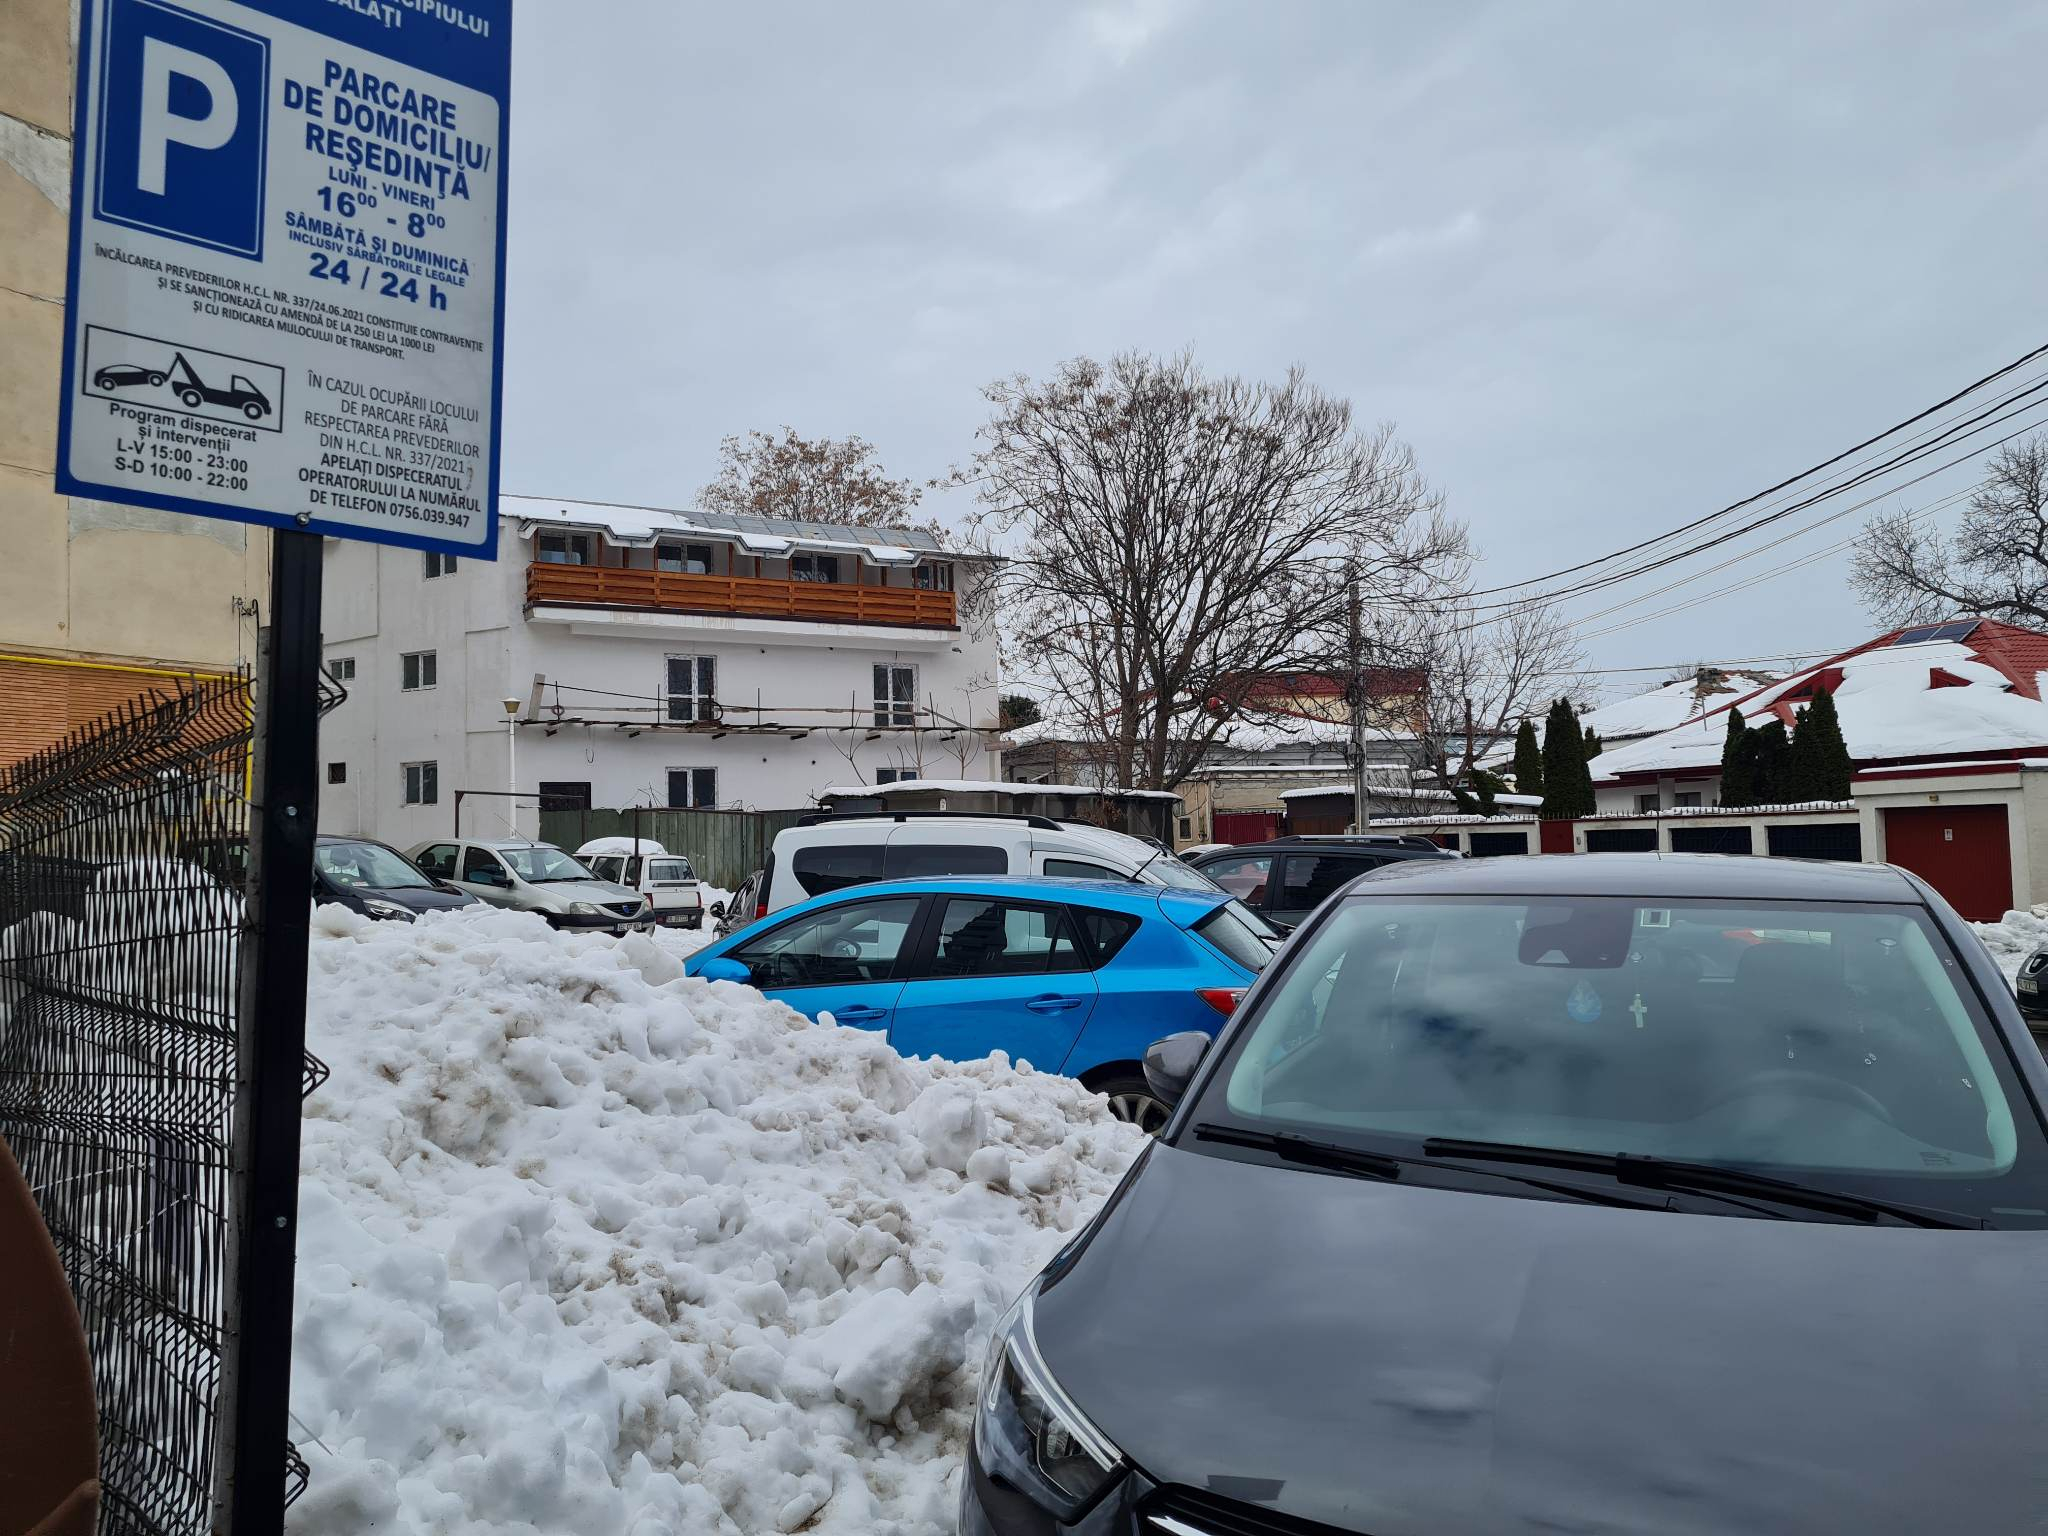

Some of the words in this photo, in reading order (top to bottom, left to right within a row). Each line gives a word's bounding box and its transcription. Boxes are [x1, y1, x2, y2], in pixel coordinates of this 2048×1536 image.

[393, 0, 489, 37] IPIULUI
[136, 36, 239, 196] P
[324, 59, 456, 131] PARCARE
[284, 78, 323, 118] DE
[334, 96, 491, 173] DOMICILIU/
[329, 166, 367, 190] LUNI
[382, 183, 435, 211] VINERI
[285, 211, 366, 247] SÂMBĂTĂ
[392, 242, 469, 276] DUMINICĂ
[289, 230, 343, 252] INCLUSIV
[426, 265, 465, 287] LEGALE
[94, 243, 162, 272] ÎNCĂLCAREA
[165, 263, 240, 292] PREVEDERILOR
[273, 291, 290, 303] NR.
[293, 295, 364, 322] 337/24.06.2021
[366, 314, 418, 336] CONSTITUIE
[309, 252, 350, 285] 24
[361, 266, 370, 290] /
[380, 272, 419, 303] 24
[430, 284, 447, 311] h
[170, 280, 182, 292] SE
[265, 301, 279, 314] CU
[281, 306, 323, 326] AMENDĂ
[326, 318, 338, 330] DE
[340, 321, 351, 333] LA
[354, 324, 370, 338] 250
[373, 329, 385, 341] LEI
[387, 332, 398, 344] LA
[400, 336, 421, 350] 1000
[423, 341, 435, 353] LEI
[205, 303, 219, 316] CU
[222, 307, 275, 329] RIDICAREA
[277, 319, 333, 344] MULOCULUI
[336, 335, 347, 347] DE
[351, 338, 404, 360] TRANSPORT.
[307, 369, 322, 389] ÎN
[326, 377, 366, 399] CAZUL
[369, 387, 426, 411] OCUPĂRII
[430, 400, 479, 423] LOCULUI
[341, 400, 357, 415] DE
[361, 403, 415, 427] PARCARE
[419, 414, 449, 434] FĂRĂ
[110, 402, 176, 427] Program
[180, 417, 257, 442] dispecerat
[305, 411, 390, 440] RESPECTAREA
[393, 429, 480, 458] PREVEDERILOR
[115, 456, 145, 473] S-D
[150, 462, 192, 482] 10:00
[207, 472, 248, 491] 22:00
[117, 438, 145, 454] L-V
[150, 444, 192, 463] 15:00
[207, 454, 248, 473] 23:00
[320, 433, 343, 450] DIN
[347, 438, 381, 458] H.C.L.
[385, 446, 406, 462] NR.
[410, 451, 465, 474] 337/2021
[376, 462, 463, 491] DISPECERATUL
[299, 468, 397, 498] OPERATORULUI
[401, 486, 415, 501] LA
[419, 489, 481, 513] NUMĂRUL
[310, 489, 327, 505] DE
[331, 492, 386, 515] TELEFON
[390, 502, 470, 528] 0756.039.947
